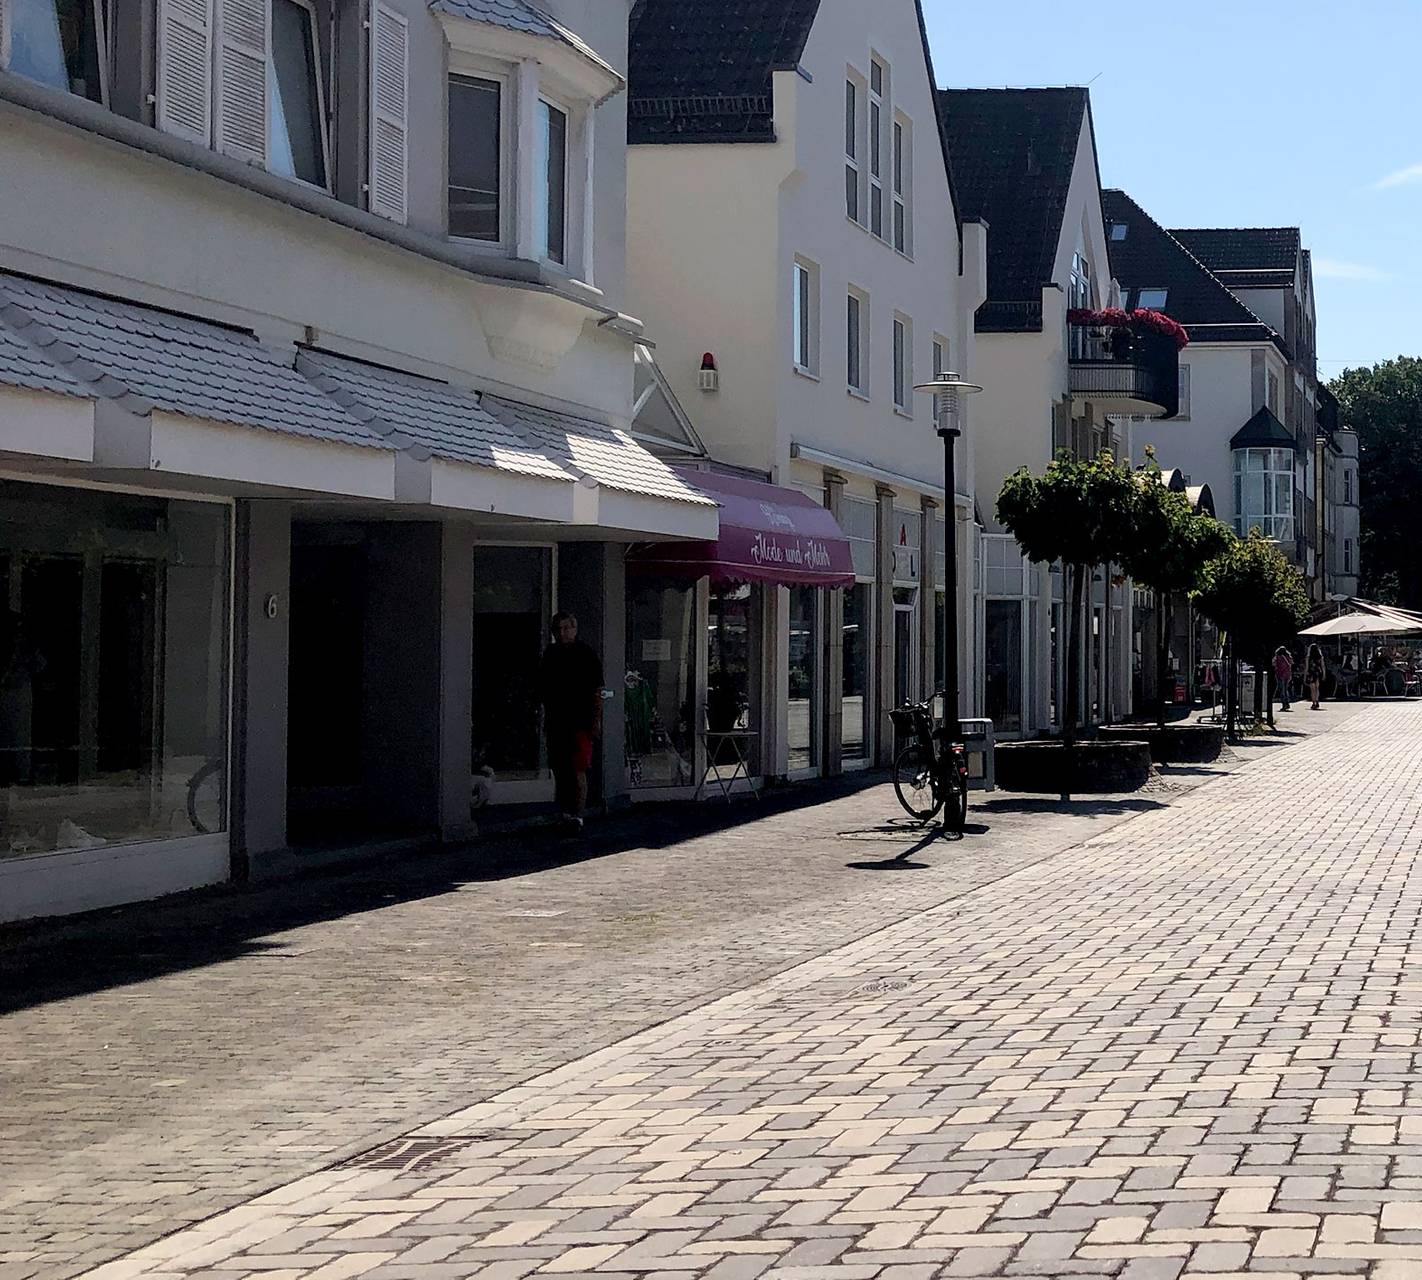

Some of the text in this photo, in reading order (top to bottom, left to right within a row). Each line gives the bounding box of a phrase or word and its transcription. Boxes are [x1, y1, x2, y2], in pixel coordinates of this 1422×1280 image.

[751, 532, 783, 564] Mode
[785, 540, 802, 564] und
[268, 594, 278, 618] 6
